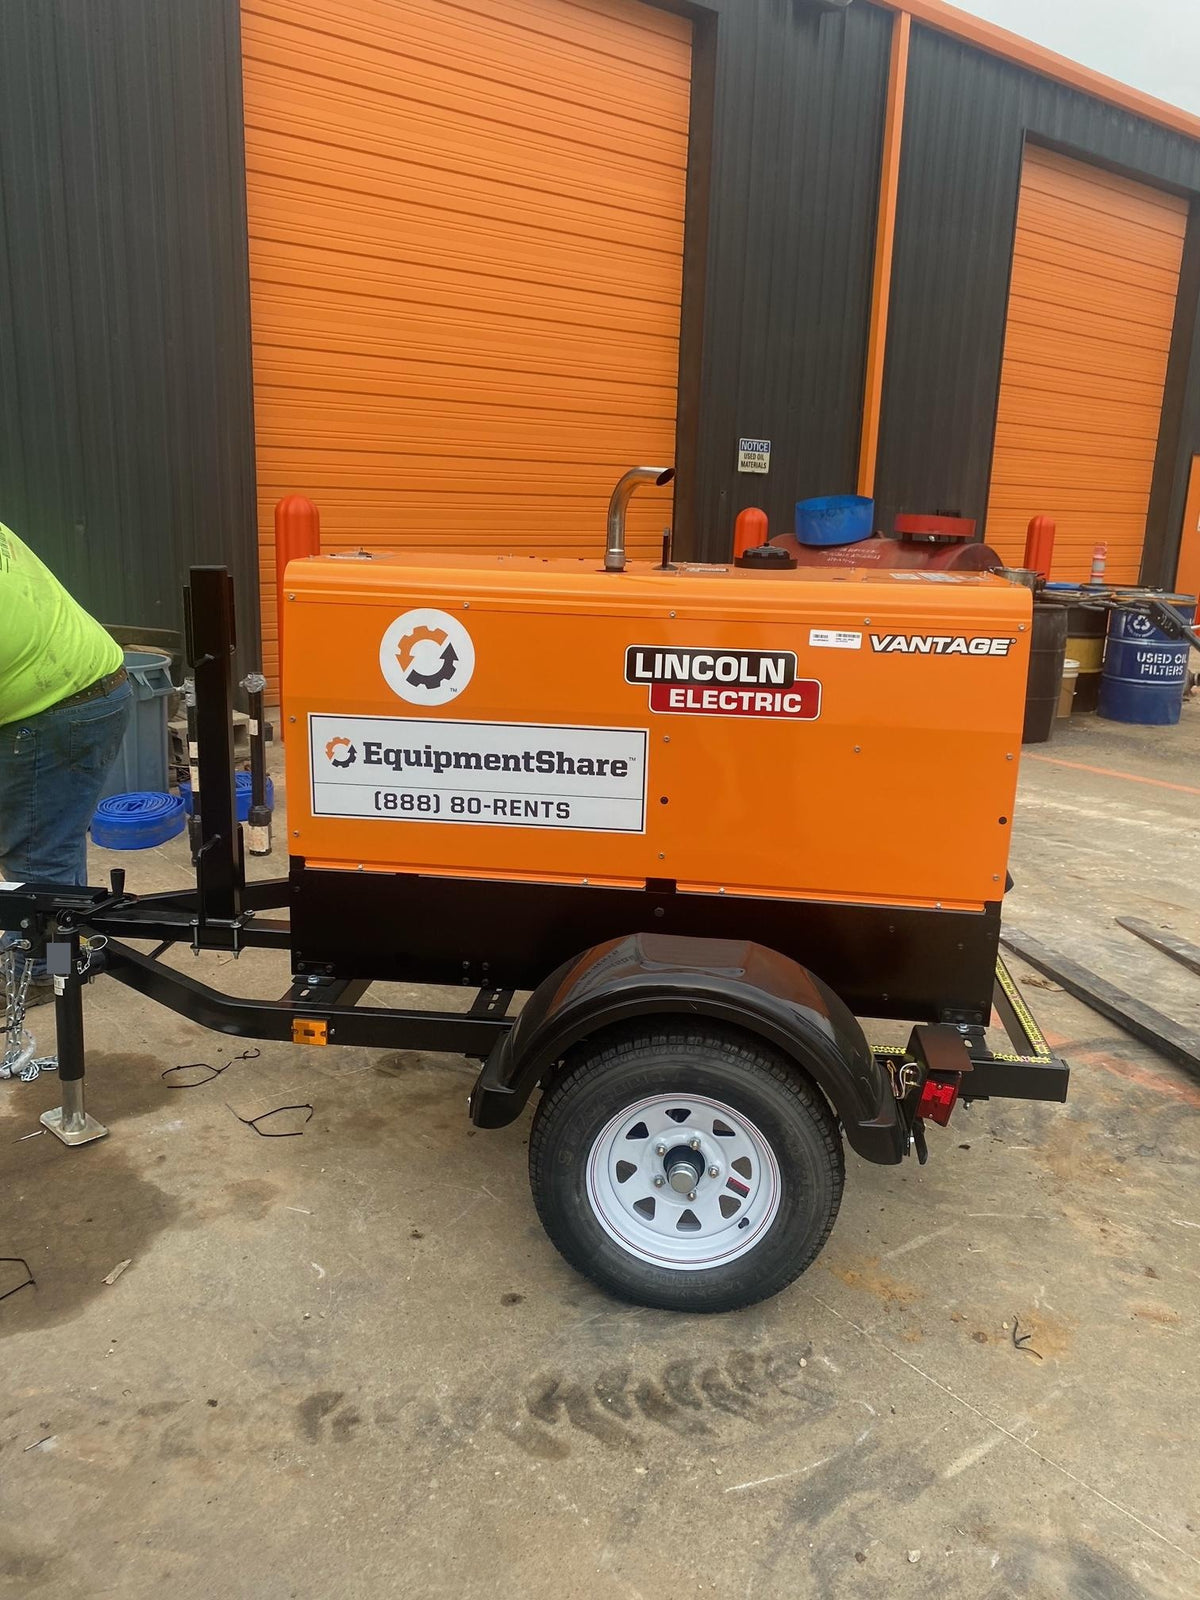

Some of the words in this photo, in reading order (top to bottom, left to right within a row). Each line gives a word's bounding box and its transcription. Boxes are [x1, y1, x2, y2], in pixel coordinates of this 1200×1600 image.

[741, 441, 768, 451] NOTICE
[741, 461, 766, 469] MATERIALS
[870, 635, 1010, 655] VANTAGE
[634, 652, 786, 684] LINCOLN
[1137, 652, 1172, 663] USED
[1174, 654, 1187, 664] OIL
[1141, 664, 1183, 676] FILTERS
[669, 687, 802, 713] ELECTRIC
[362, 741, 628, 778] EquipmentShare
[374, 791, 441, 814] (888)
[450, 796, 571, 819] 80-RENTS
